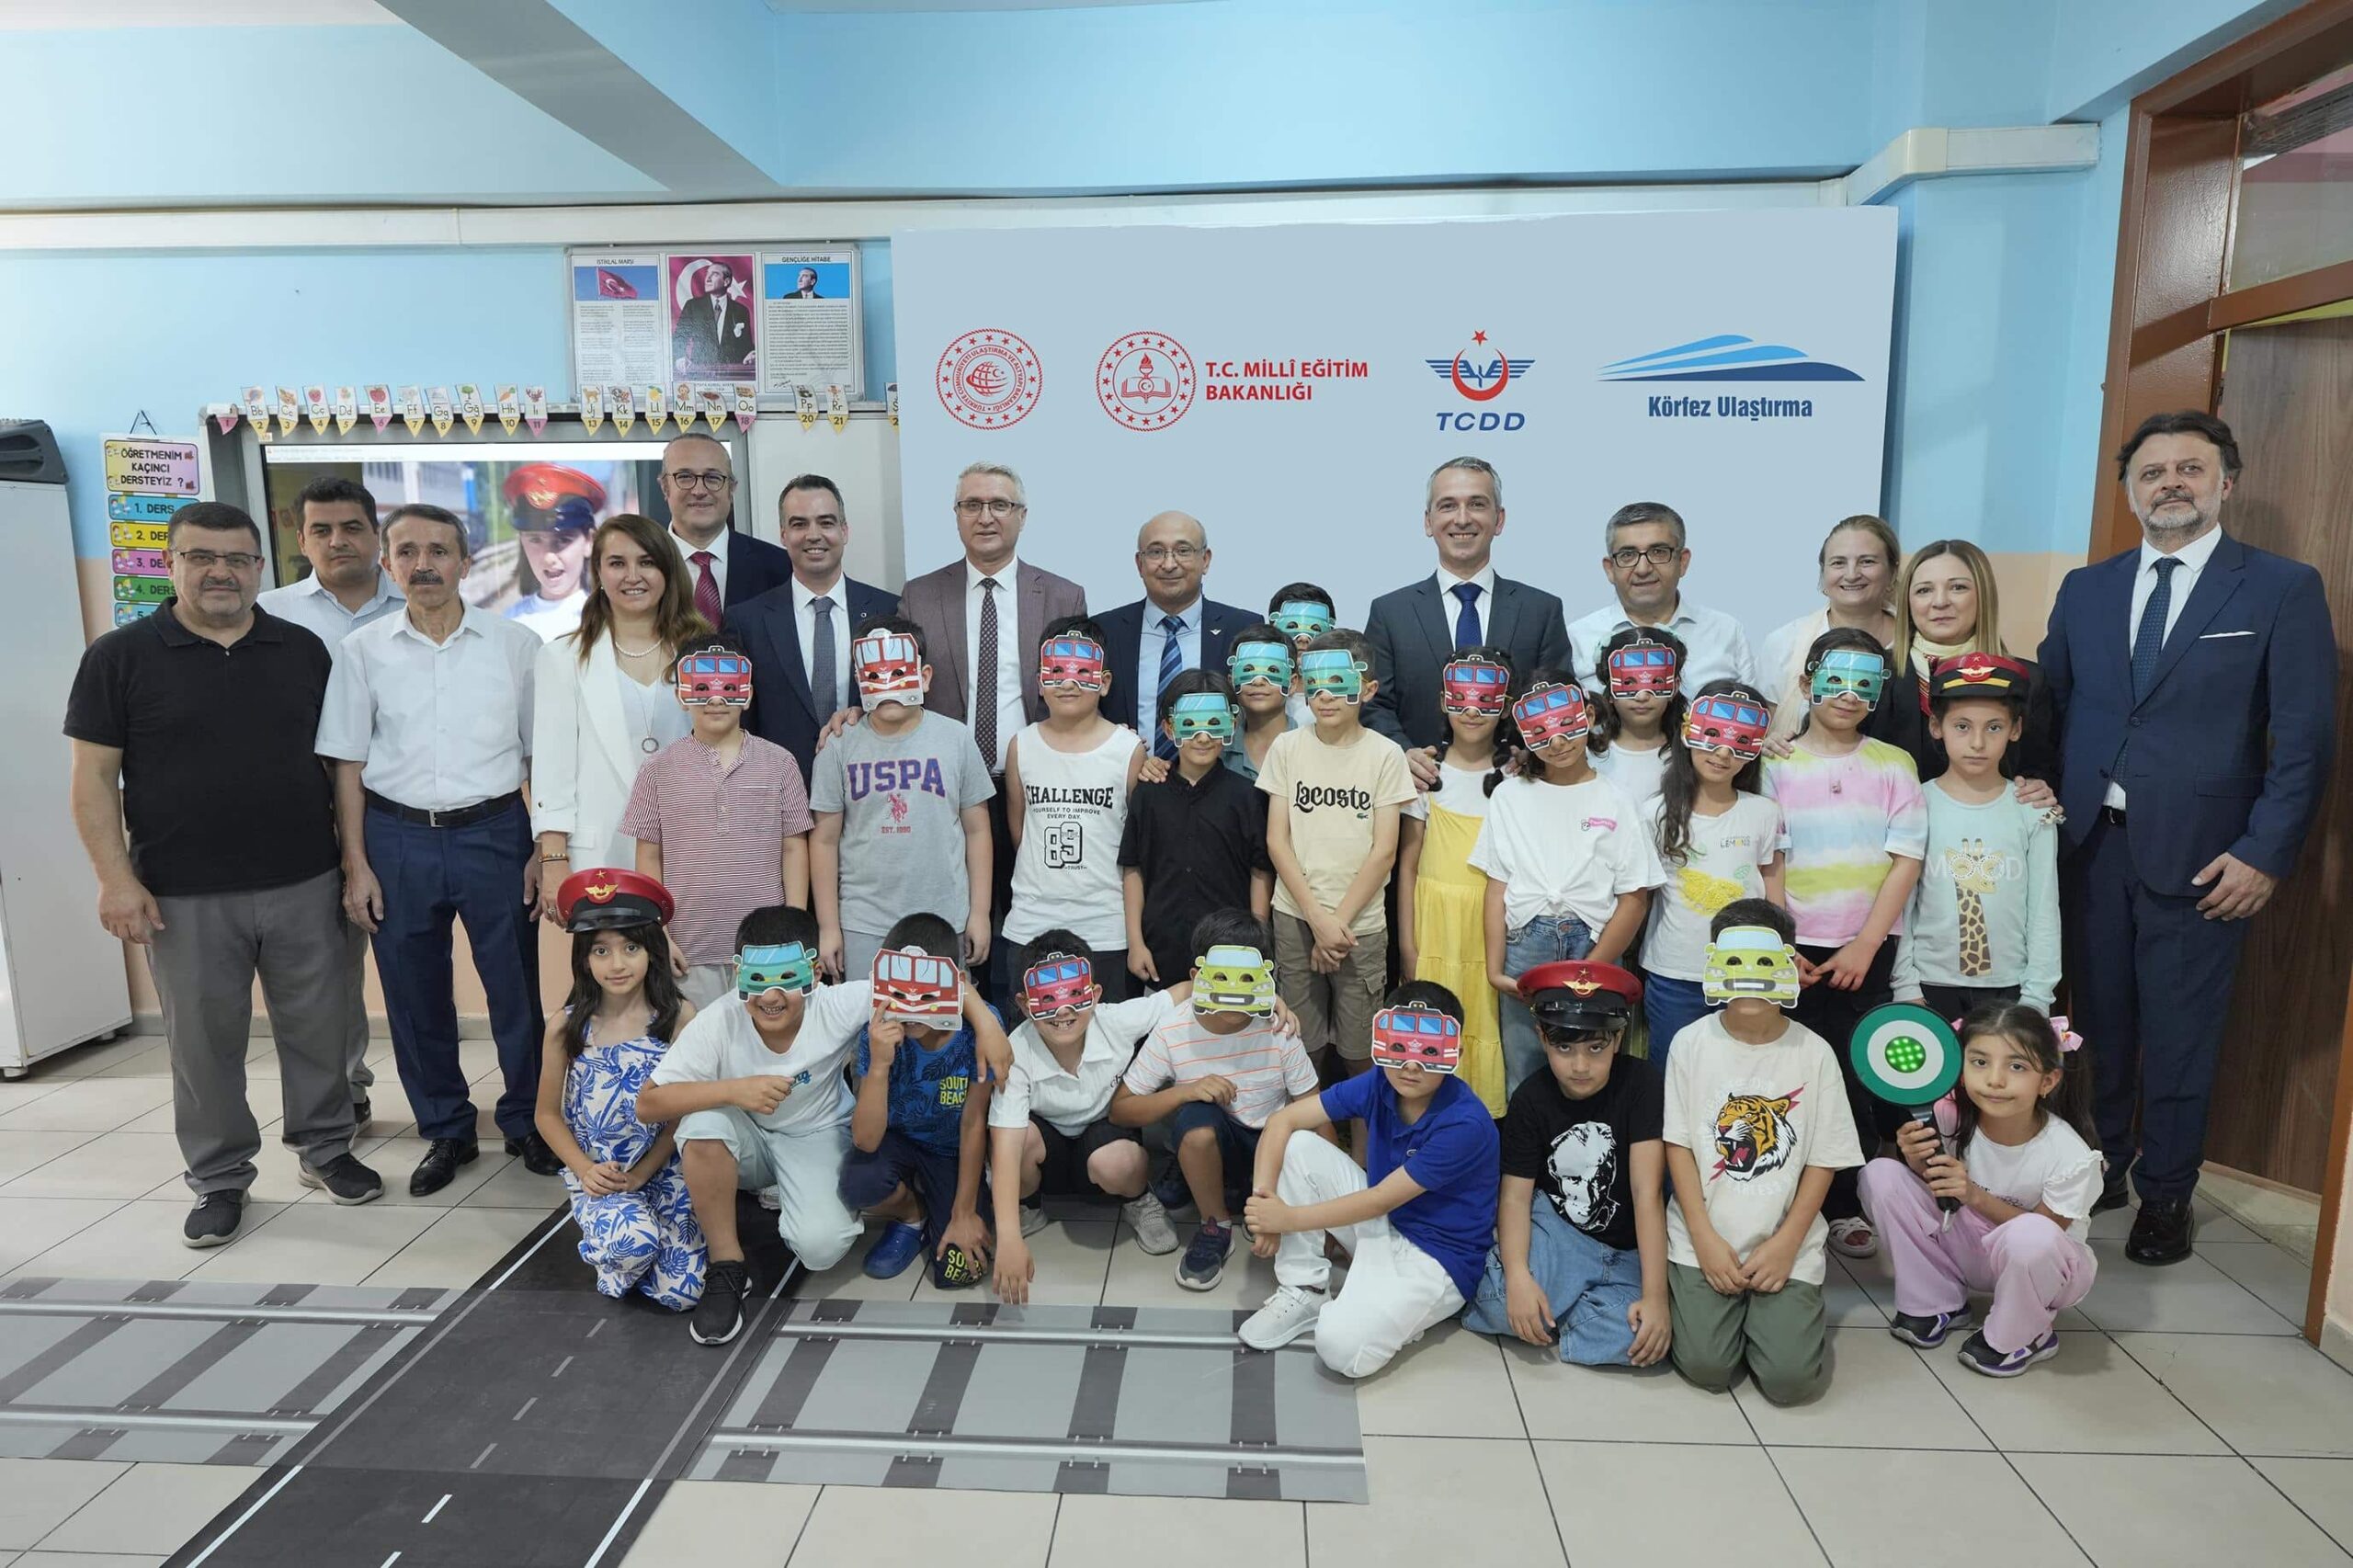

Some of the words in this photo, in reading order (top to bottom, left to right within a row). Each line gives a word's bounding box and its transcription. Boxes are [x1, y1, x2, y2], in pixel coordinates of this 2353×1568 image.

[1205, 361, 1239, 378] T.C.
[1244, 358, 1295, 378] MİLLÎ
[1301, 358, 1368, 378] EĞİTİM
[1205, 381, 1312, 401] BAKANLIĞI
[1648, 396, 1711, 417] Körfez
[1717, 396, 1813, 421] Ulaştırma
[1436, 412, 1525, 431] TCDD
[120, 447, 183, 460] ÖĞRETMENİM
[131, 462, 170, 473] KAÇINCI
[120, 475, 172, 486] DERSTEYİZ
[177, 477, 184, 487] ?
[134, 503, 142, 514] 1.
[147, 504, 175, 514] DERS
[136, 530, 145, 540] 2.
[136, 558, 145, 568] 3.
[136, 585, 145, 595] 4.
[847, 758, 945, 801] USPA
[1026, 784, 1113, 809] CHALLENGE
[1293, 779, 1371, 813] Lacoste
[1044, 821, 1083, 869] 89
[939, 1091, 967, 1106] BEAC
